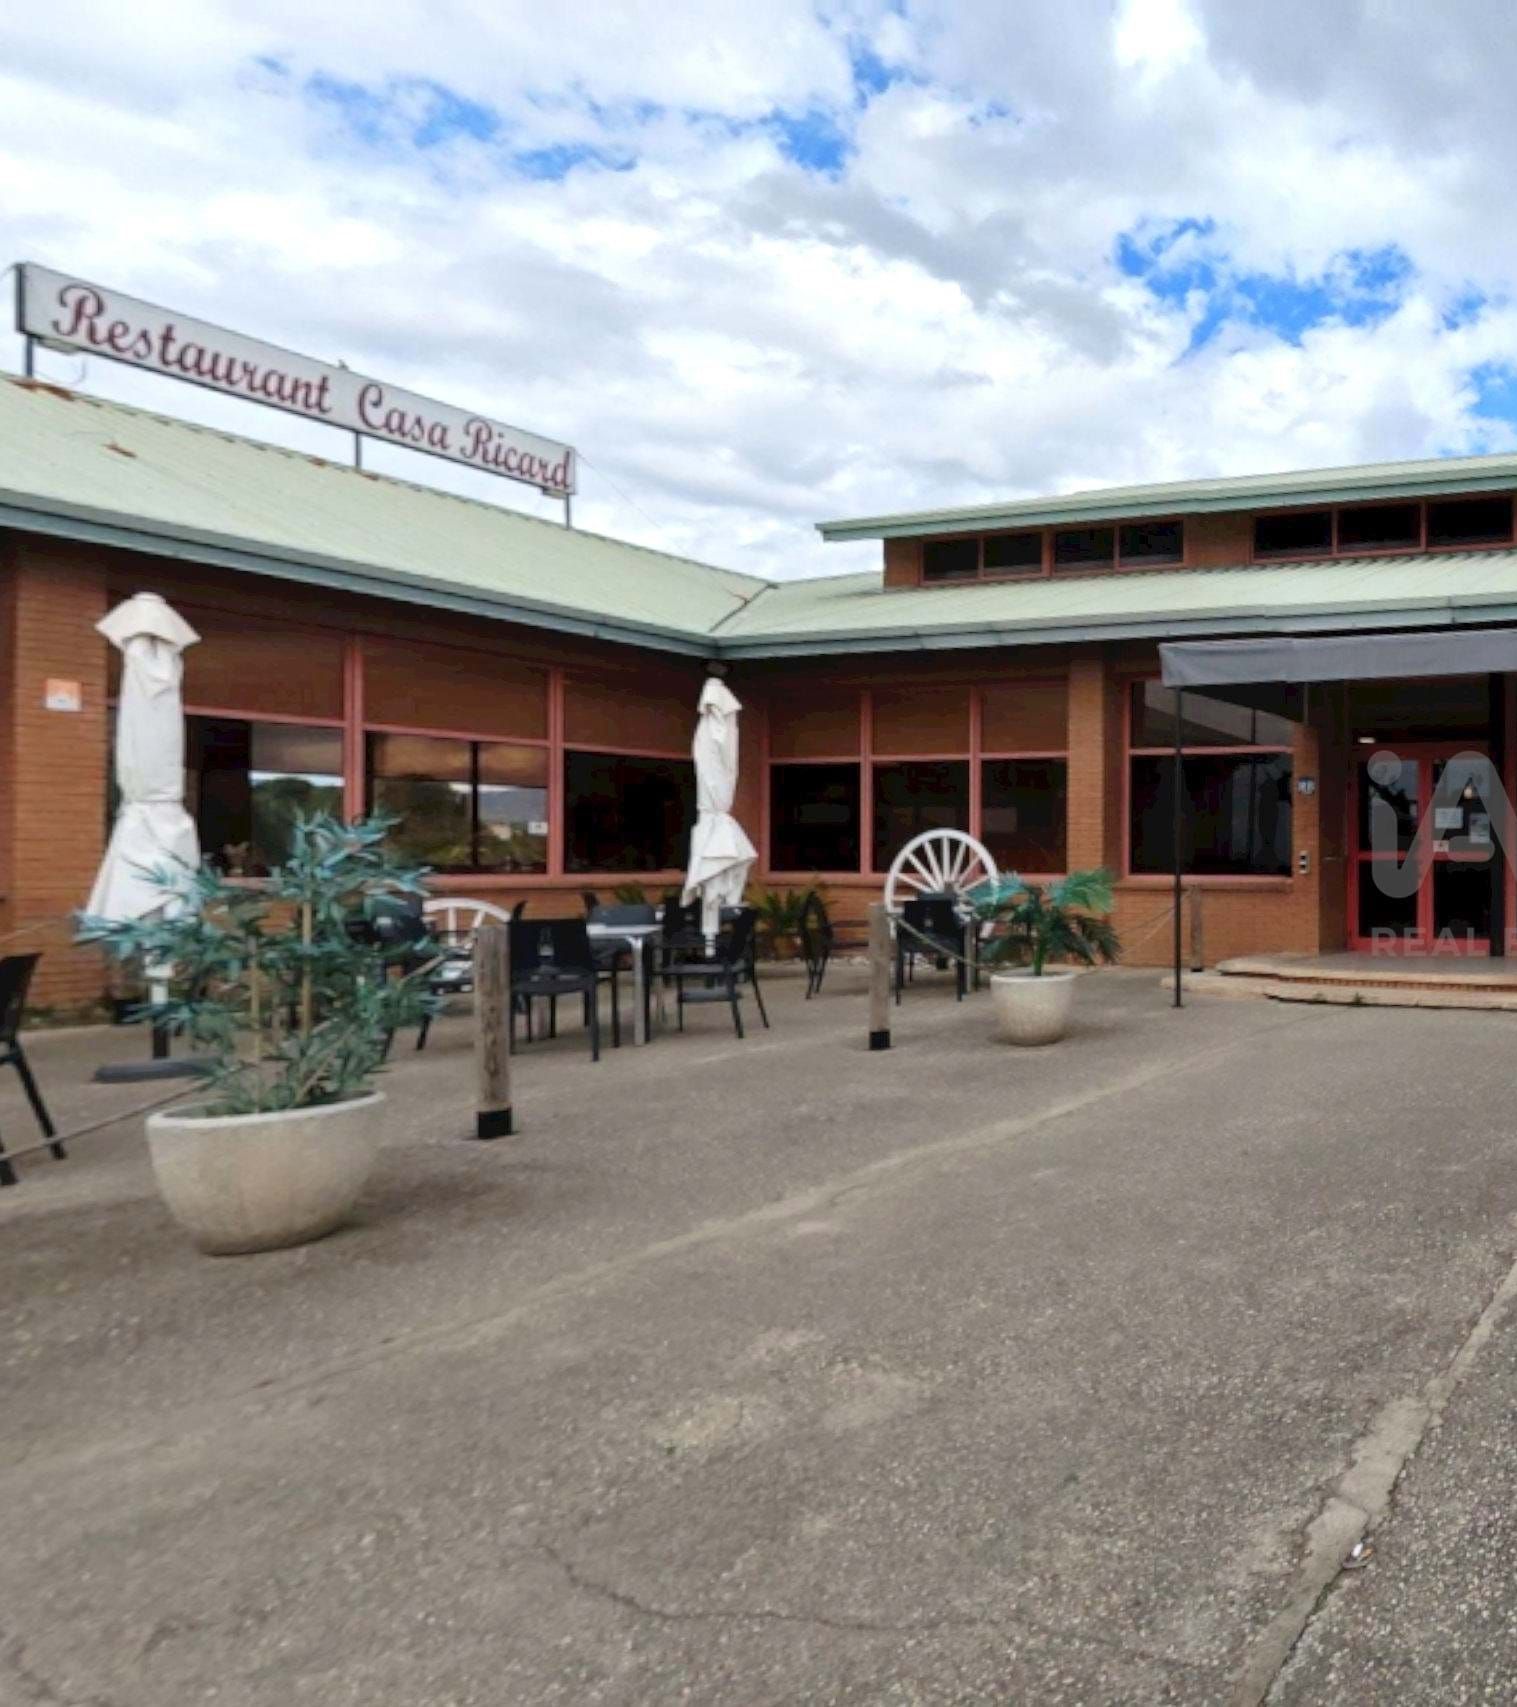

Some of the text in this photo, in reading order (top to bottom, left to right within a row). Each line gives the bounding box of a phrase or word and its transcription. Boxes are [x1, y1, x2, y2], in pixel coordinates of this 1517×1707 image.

[53, 284, 571, 489] Restaurant Casa Ricard
